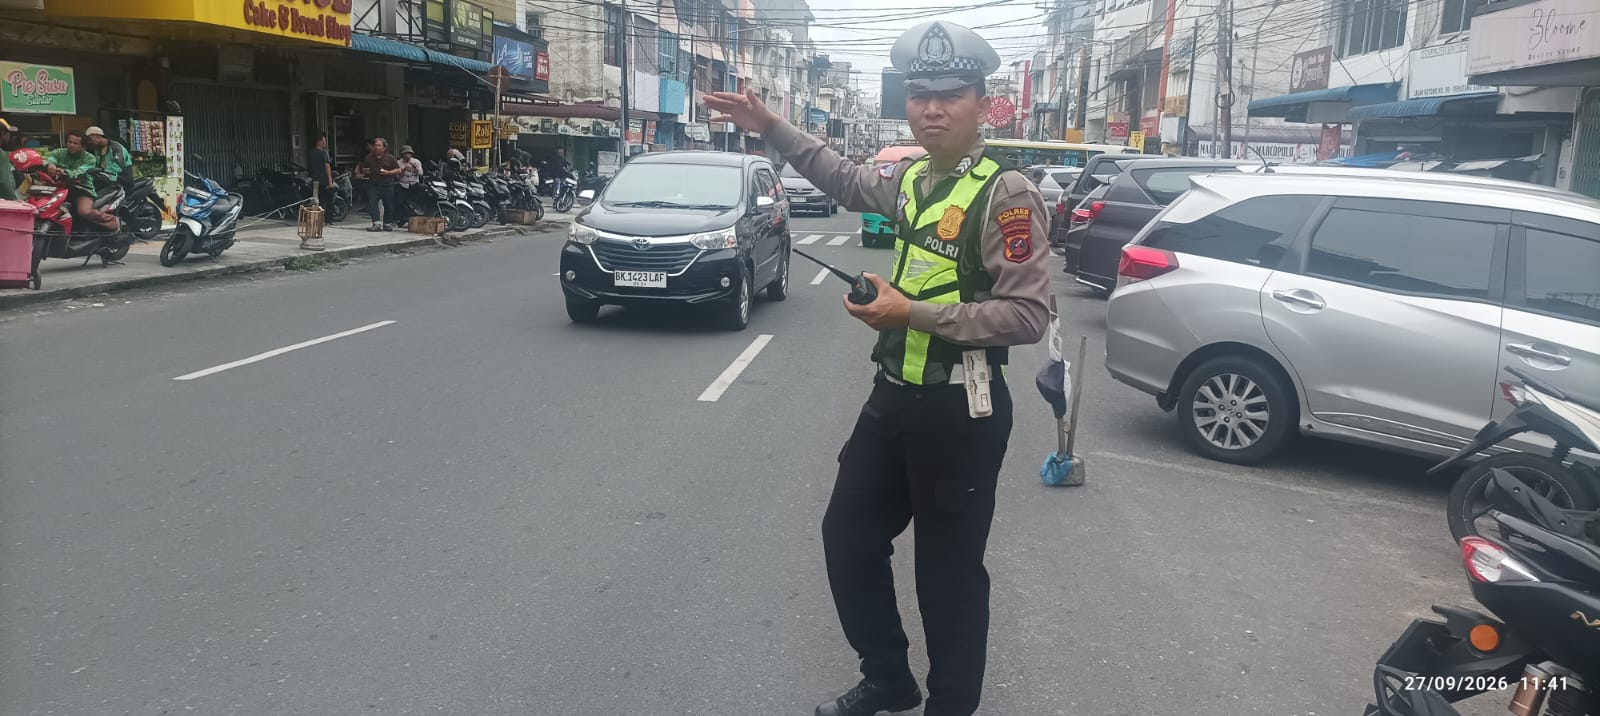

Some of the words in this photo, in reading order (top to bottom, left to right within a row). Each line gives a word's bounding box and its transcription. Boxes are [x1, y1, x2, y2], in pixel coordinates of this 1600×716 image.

[243, 0, 277, 28] Cake
[278, 4, 289, 31] &
[290, 8, 324, 37] Bread
[325, 15, 351, 47] Shop
[7, 69, 35, 98] Pie
[36, 69, 68, 96] Susu
[998, 208, 1029, 221] POLRES
[924, 235, 959, 258] POLRI
[616, 272, 626, 281] BK
[628, 272, 648, 282] 1423
[649, 273, 664, 283] LAF
